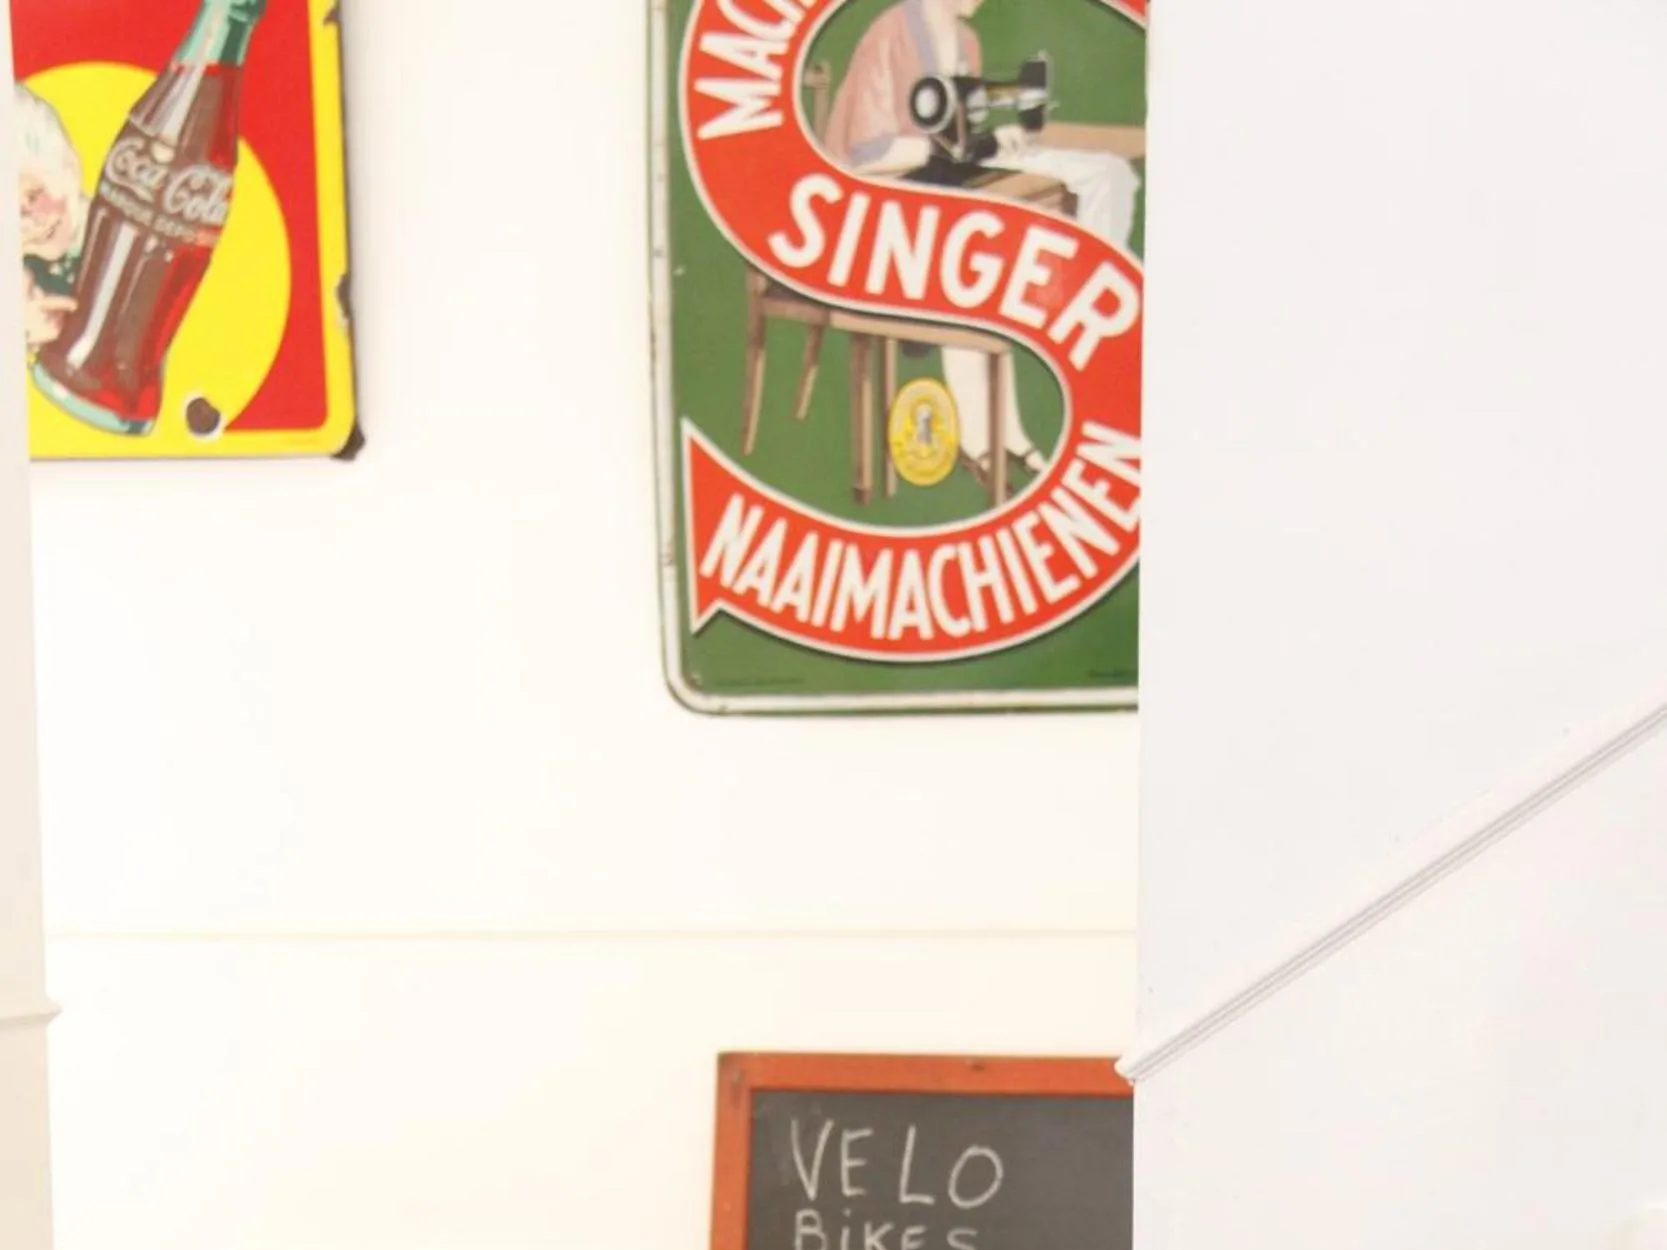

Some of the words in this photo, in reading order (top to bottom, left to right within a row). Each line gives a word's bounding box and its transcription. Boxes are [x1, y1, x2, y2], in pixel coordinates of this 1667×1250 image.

[767, 173, 1139, 371] SINGER
[701, 421, 1141, 641] NAAIMACHIENEN
[791, 1118, 1003, 1209] VELO
